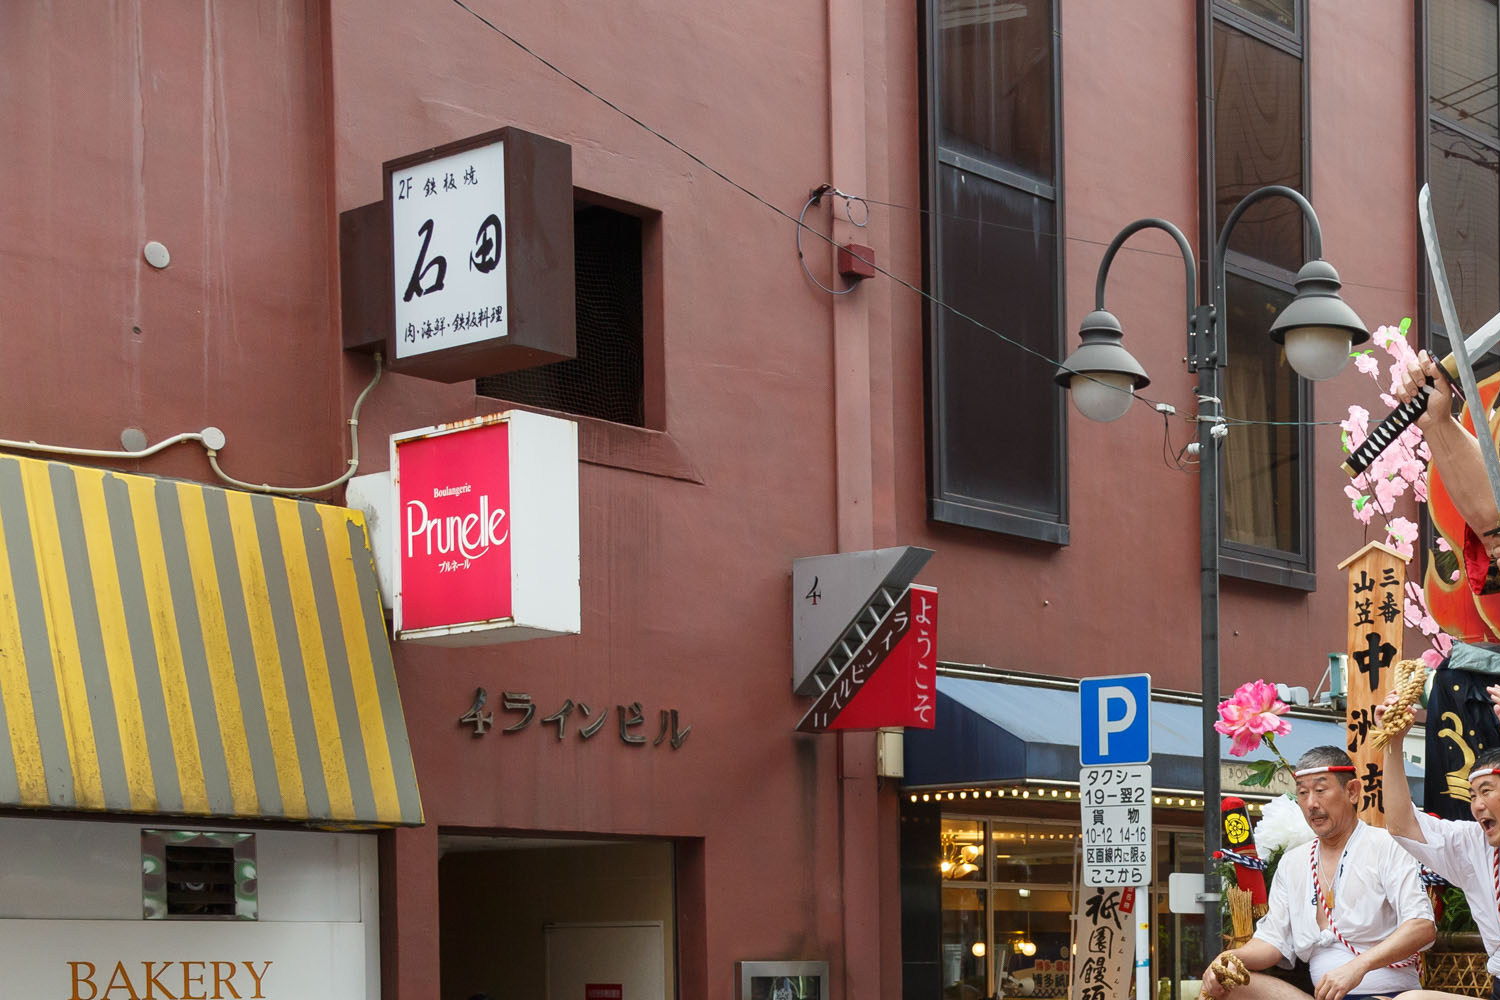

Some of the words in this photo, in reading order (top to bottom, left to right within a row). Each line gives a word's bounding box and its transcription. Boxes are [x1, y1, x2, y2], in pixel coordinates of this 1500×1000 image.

[398, 177, 413, 200] 2F
[423, 165, 479, 198] 鉄板焼
[403, 214, 503, 302] 石田
[434, 483, 471, 498] Boulangerie
[407, 495, 509, 559] Prunelle
[1353, 571, 1375, 628] 山笠
[1378, 568, 1401, 624] 三番
[914, 596, 933, 722] ようこそ
[459, 687, 692, 749] 4ラインビル
[1098, 686, 1137, 756] P
[1087, 770, 1142, 785] タクシー
[1085, 828, 1113, 844] 10-12
[1119, 826, 1146, 843] 14-16
[1091, 868, 1143, 884] ここから
